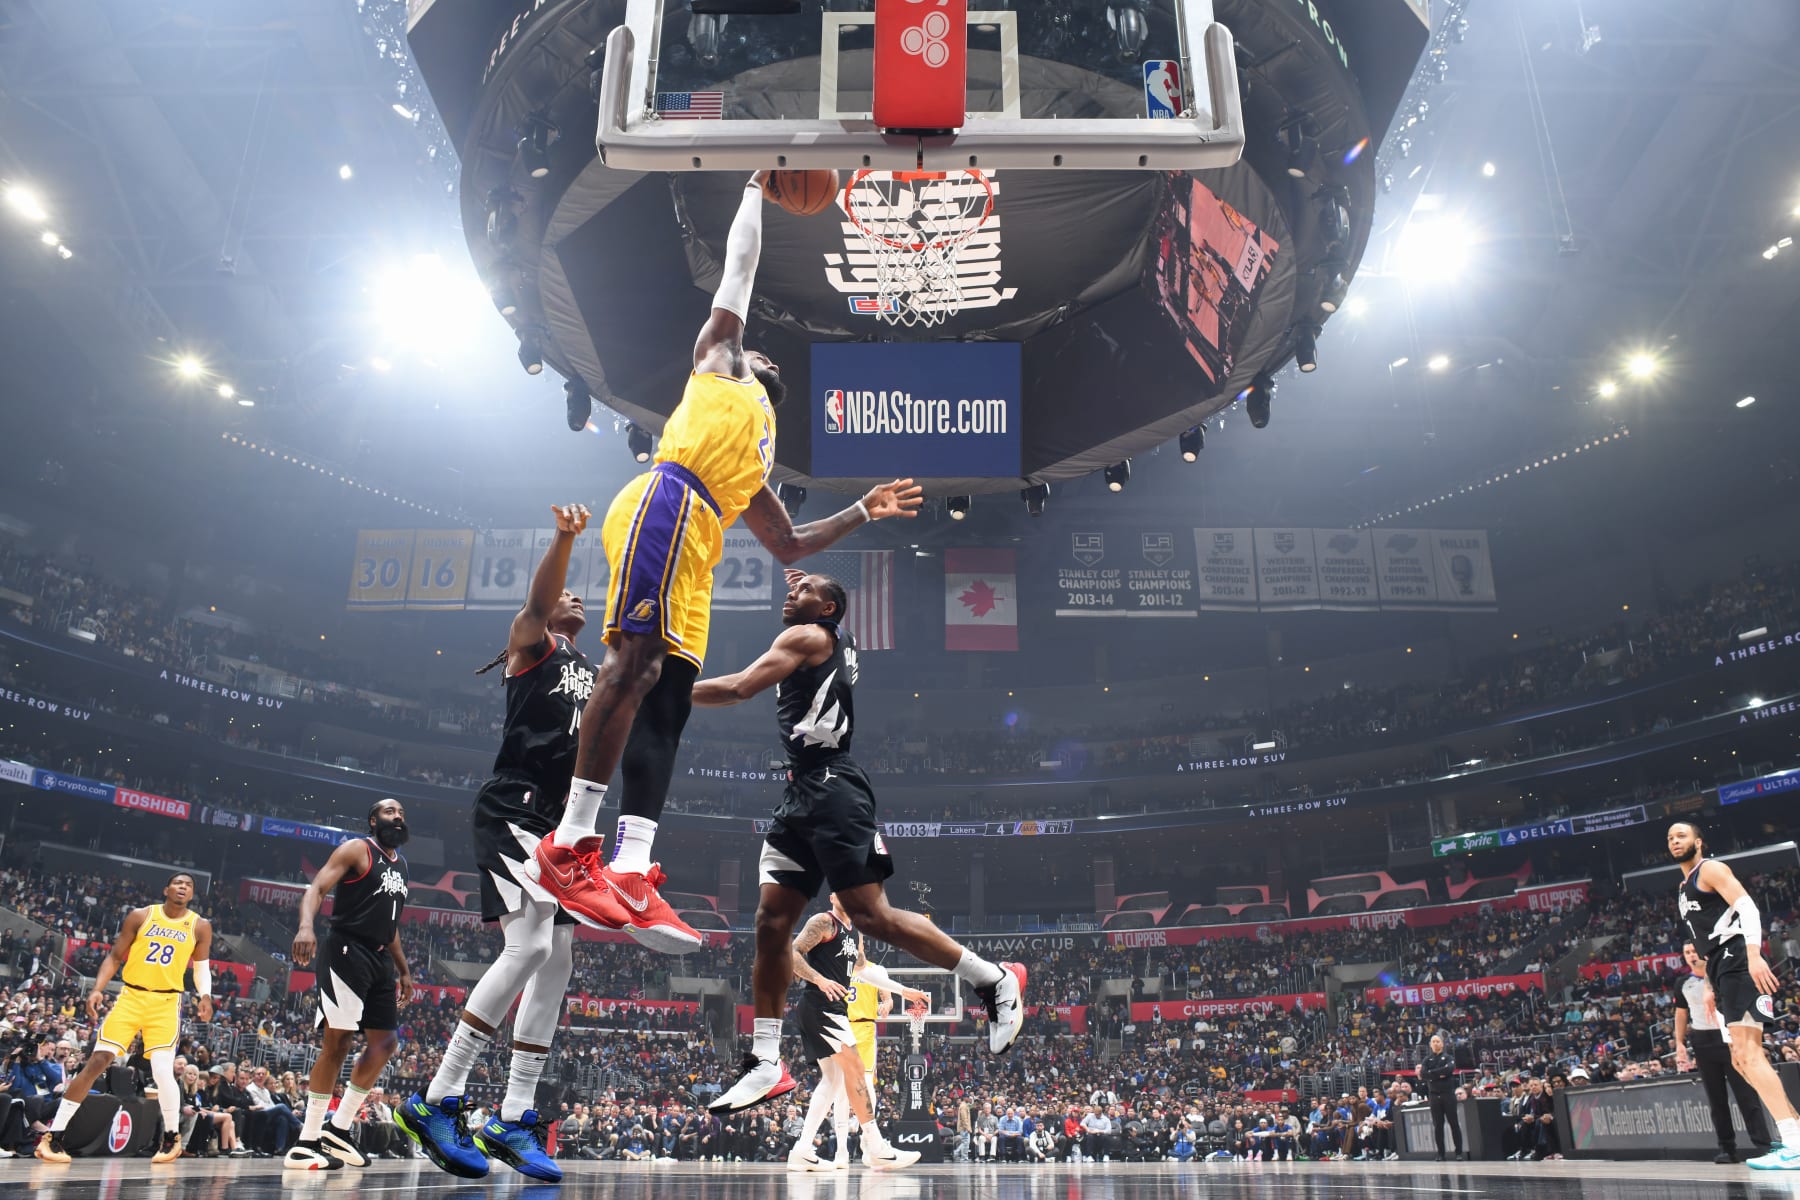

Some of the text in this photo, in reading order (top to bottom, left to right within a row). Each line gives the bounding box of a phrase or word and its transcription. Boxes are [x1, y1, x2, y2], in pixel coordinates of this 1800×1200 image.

[846, 391, 1007, 434] NBAStore.com
[1439, 538, 1480, 549] MILLER
[357, 557, 401, 589] 30
[421, 557, 457, 589] 16
[481, 557, 517, 588] 18
[721, 557, 764, 589] 23
[1059, 569, 1120, 579] STANLEY CUP
[1128, 570, 1191, 579] STANLEY CUP
[1059, 579, 1121, 589] CHAMPIONS
[1128, 580, 1191, 590] CHAMPIONS
[1068, 593, 1114, 605] 2013-14
[1139, 594, 1183, 606] 2011-12
[1715, 656, 1724, 666] A
[160, 669, 284, 709] A THREE-ROW SUV
[64, 707, 91, 721] SUV
[1740, 715, 1747, 723] A
[1177, 752, 1287, 772] A THREE-ROW SUV
[0, 763, 28, 781] ealth
[688, 767, 695, 776] A
[701, 768, 767, 780] THREE-ROW
[57, 779, 107, 796] crypto.com
[1763, 776, 1798, 791] ULTRA
[119, 790, 186, 817] TOSHIBA
[1249, 797, 1348, 817] A THREE-ROW SUV
[302, 825, 330, 841] ULTRA
[889, 824, 926, 836] 10:03
[932, 827, 937, 836] 1
[950, 825, 976, 835] Lakers
[996, 824, 1005, 835] 4
[1062, 825, 1068, 833] 7
[1520, 823, 1567, 840] DELTA
[1463, 833, 1493, 851] Sprite
[391, 899, 397, 921] 1
[144, 924, 187, 942] LAKERS
[1125, 931, 1167, 948] CLIPPERS
[145, 941, 175, 965] 28
[911, 1081, 922, 1091] GET
[1607, 1105, 1655, 1135] Celebrates
[1654, 1102, 1685, 1134] Black
[898, 1133, 934, 1144] KIA
